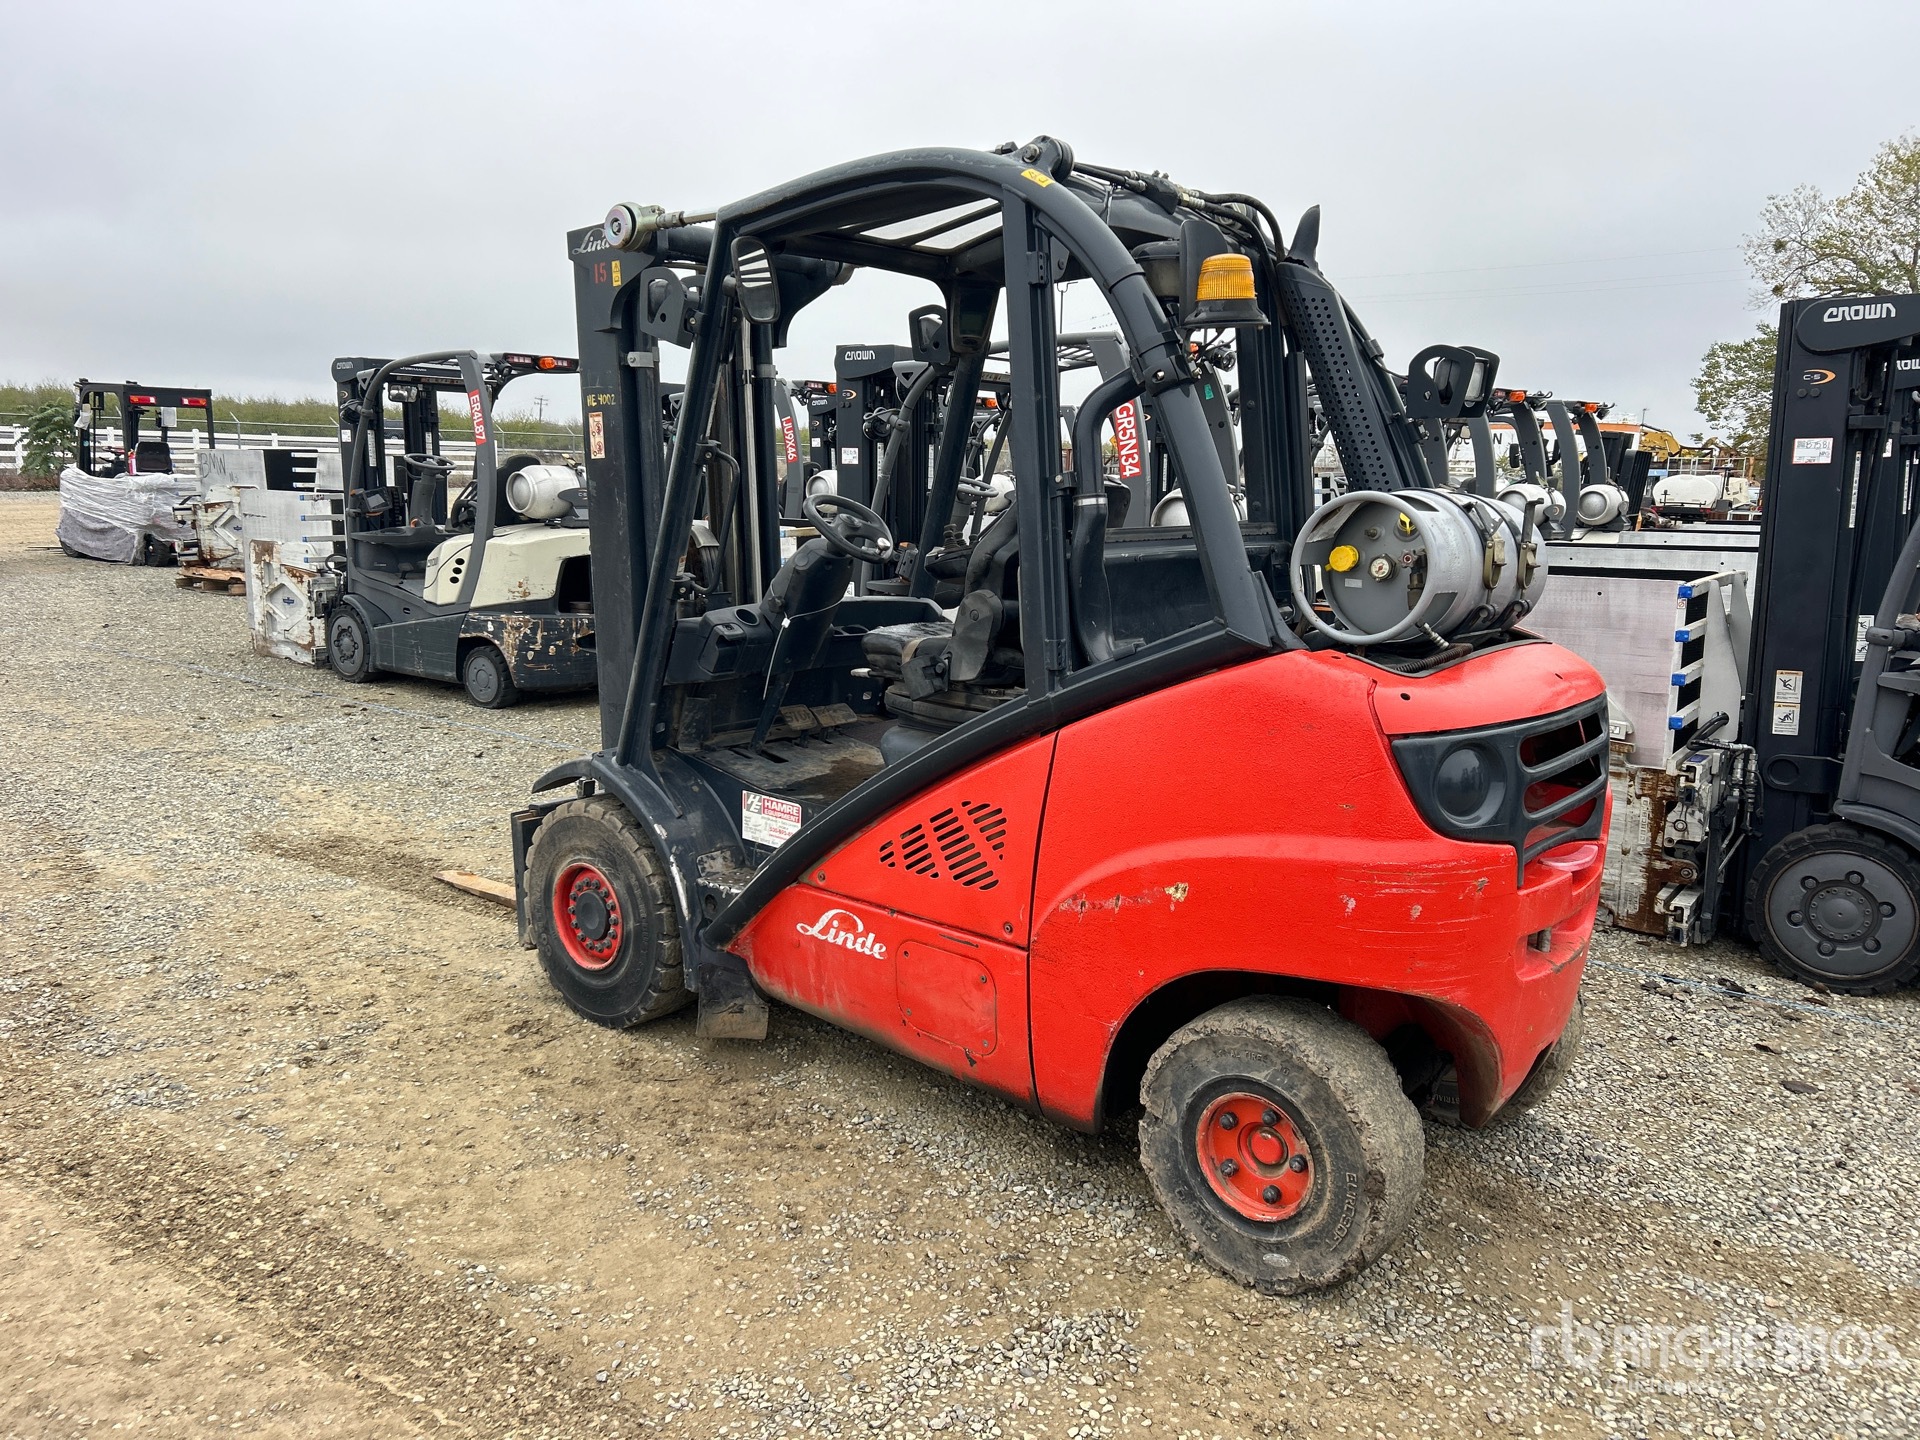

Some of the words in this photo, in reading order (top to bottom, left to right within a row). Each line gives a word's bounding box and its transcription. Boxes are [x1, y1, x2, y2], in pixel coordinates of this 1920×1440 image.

[1823, 303, 1896, 323] CROWN
[844, 350, 876, 361] CROWN
[1115, 402, 1141, 478] GR5N34
[200, 452, 226, 479] BMW
[764, 798, 800, 816] HAMRE
[796, 908, 887, 960] Linde
